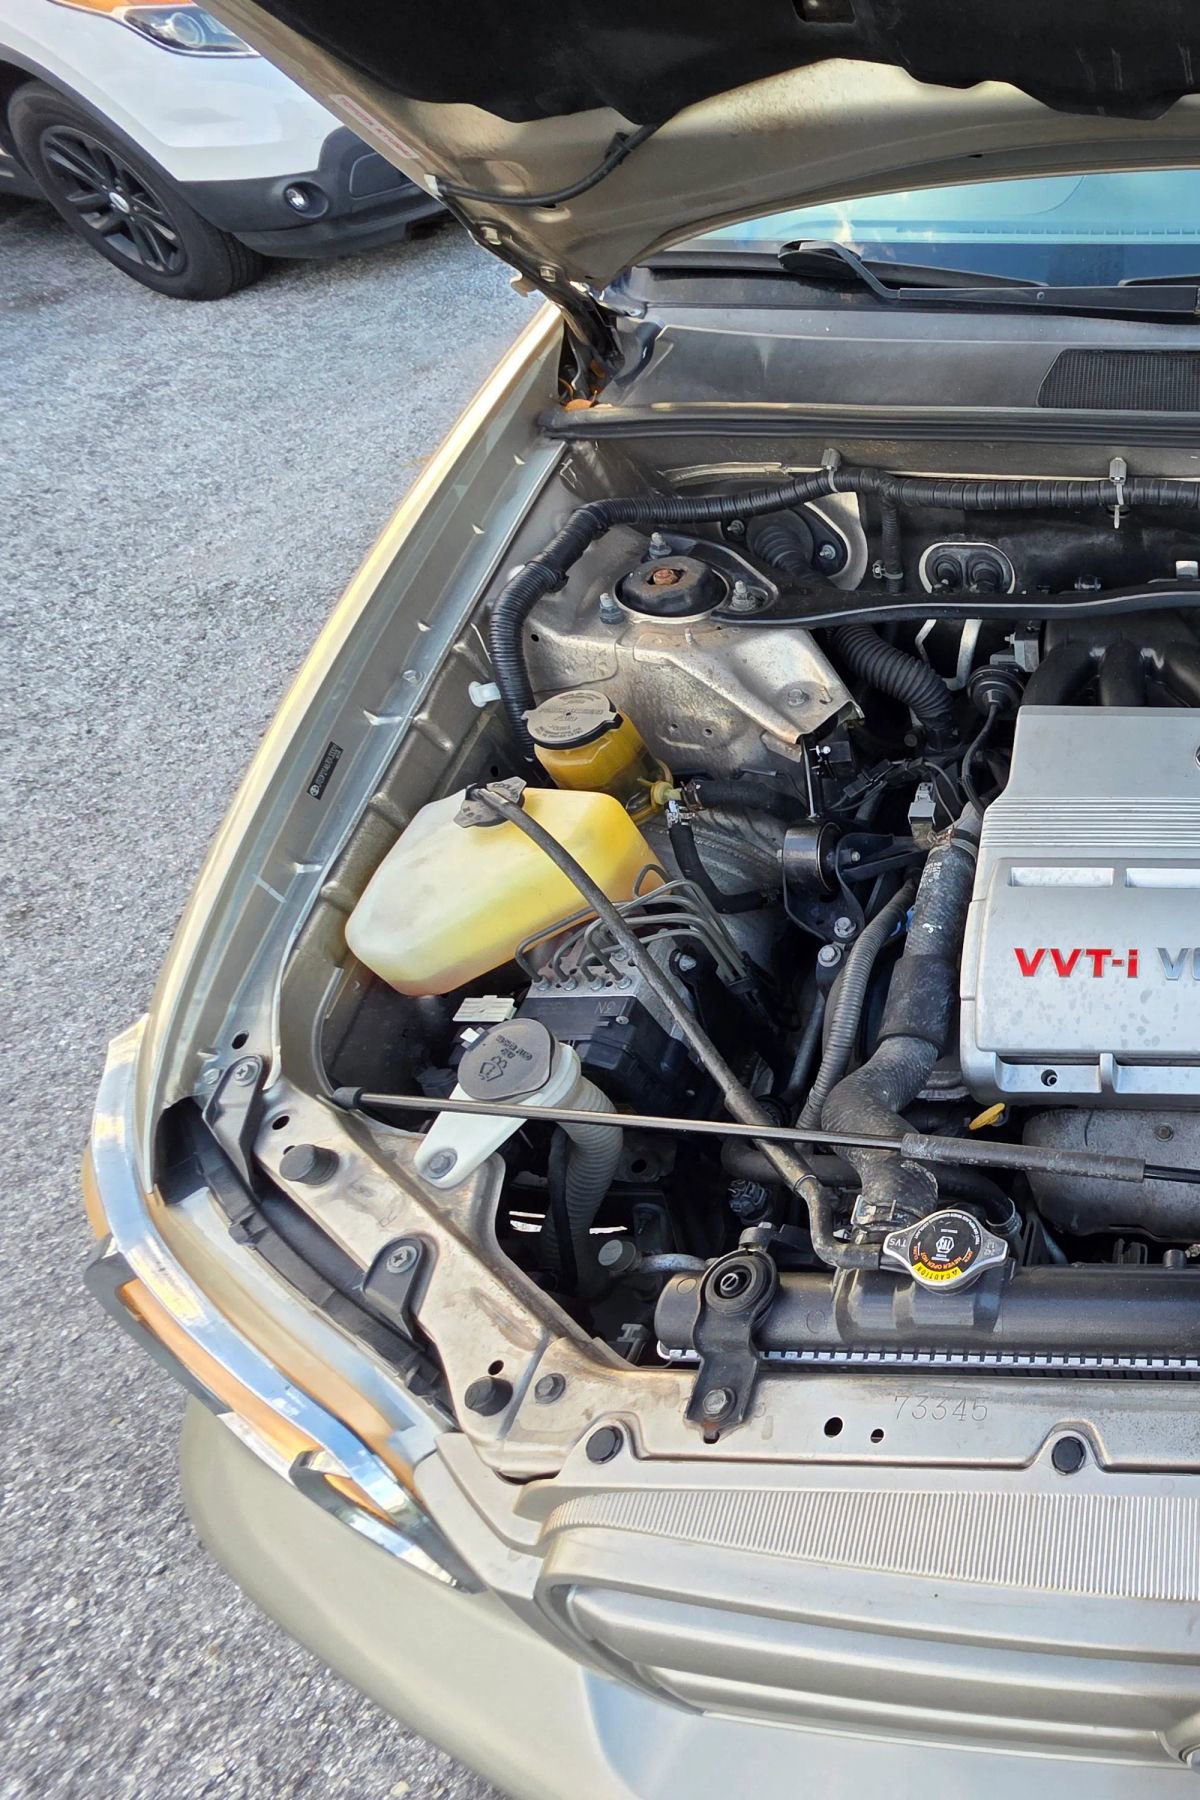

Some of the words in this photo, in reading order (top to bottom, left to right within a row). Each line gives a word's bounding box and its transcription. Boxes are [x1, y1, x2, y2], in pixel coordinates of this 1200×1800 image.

[1013, 946, 1139, 980] VVT-i
[919, 1251, 929, 1264] HOT
[927, 1260, 942, 1270] OPEN
[942, 1256, 962, 1270] NEVER
[916, 1265, 951, 1281] CAUTION
[894, 1394, 990, 1422] 73345
